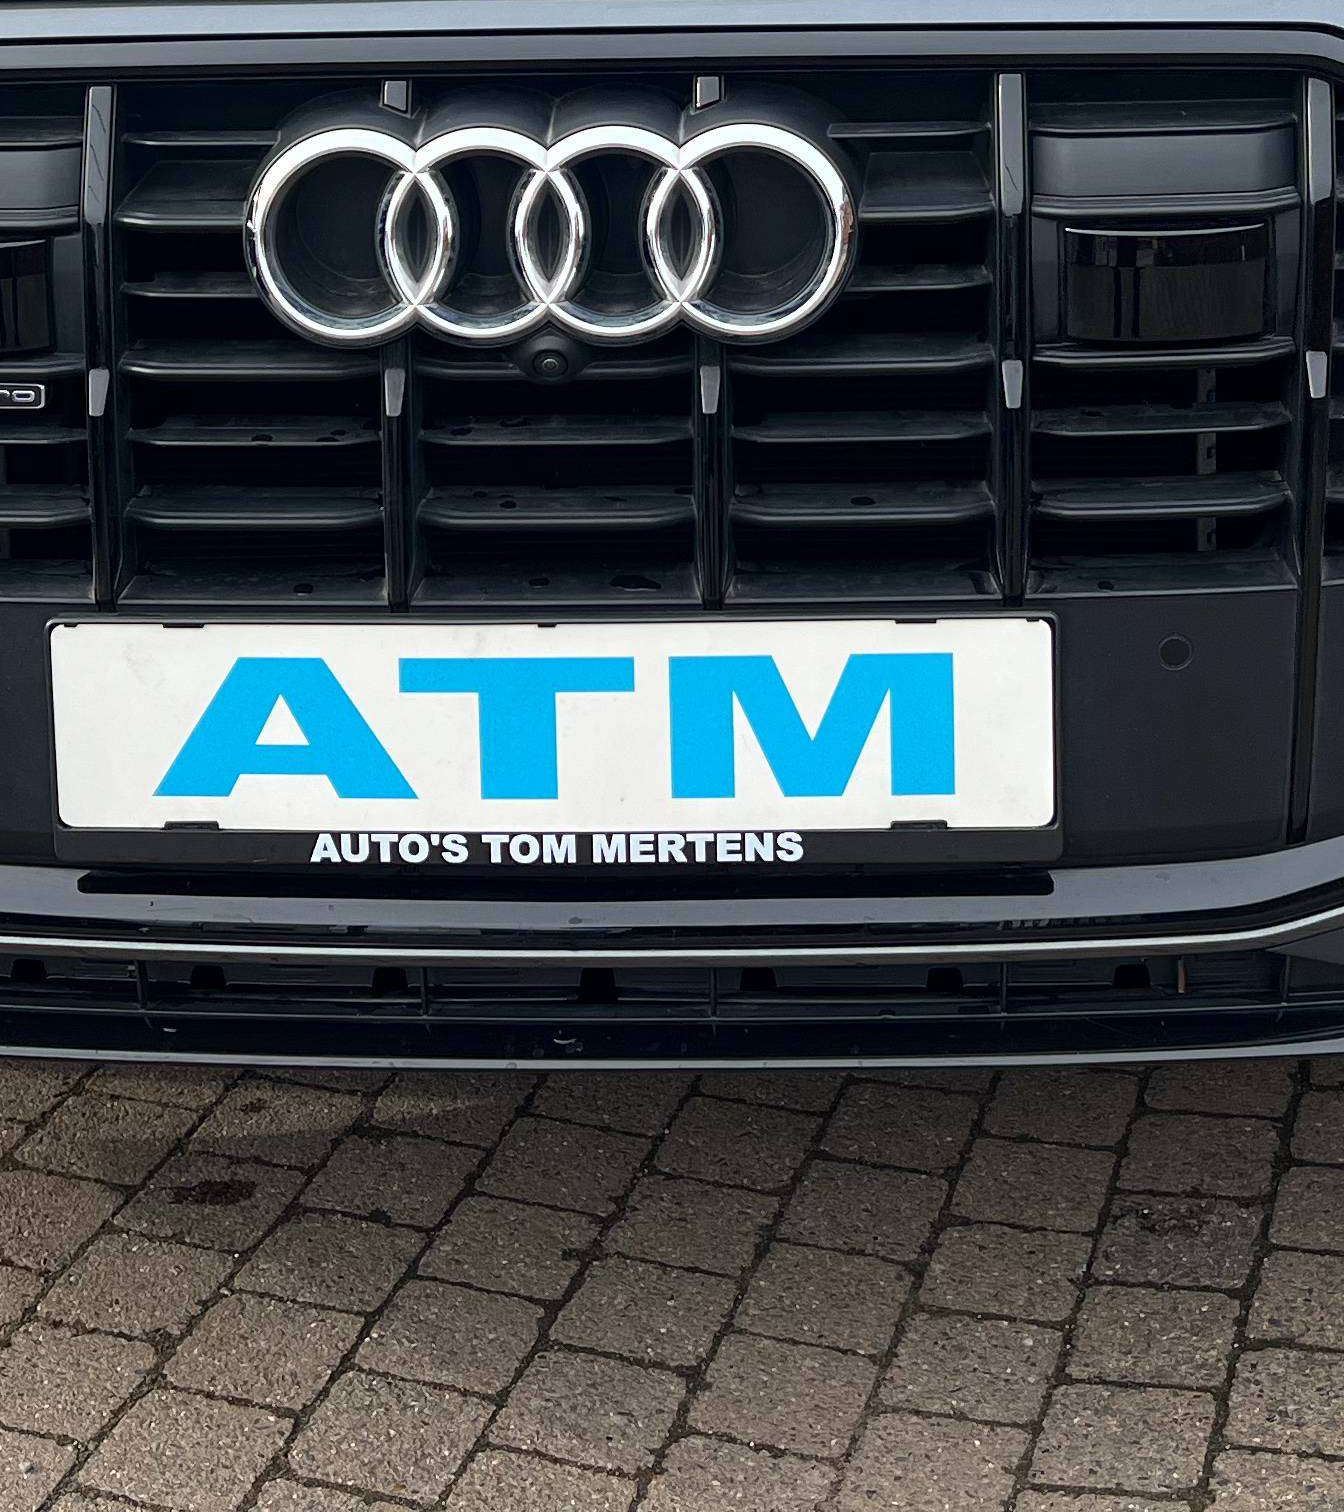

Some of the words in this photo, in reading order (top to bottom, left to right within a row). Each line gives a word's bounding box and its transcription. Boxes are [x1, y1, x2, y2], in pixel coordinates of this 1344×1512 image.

[153, 652, 956, 801] ATM
[310, 833, 469, 864] AUTO'S
[481, 833, 577, 864] TOM
[592, 831, 804, 864] MERTENS
